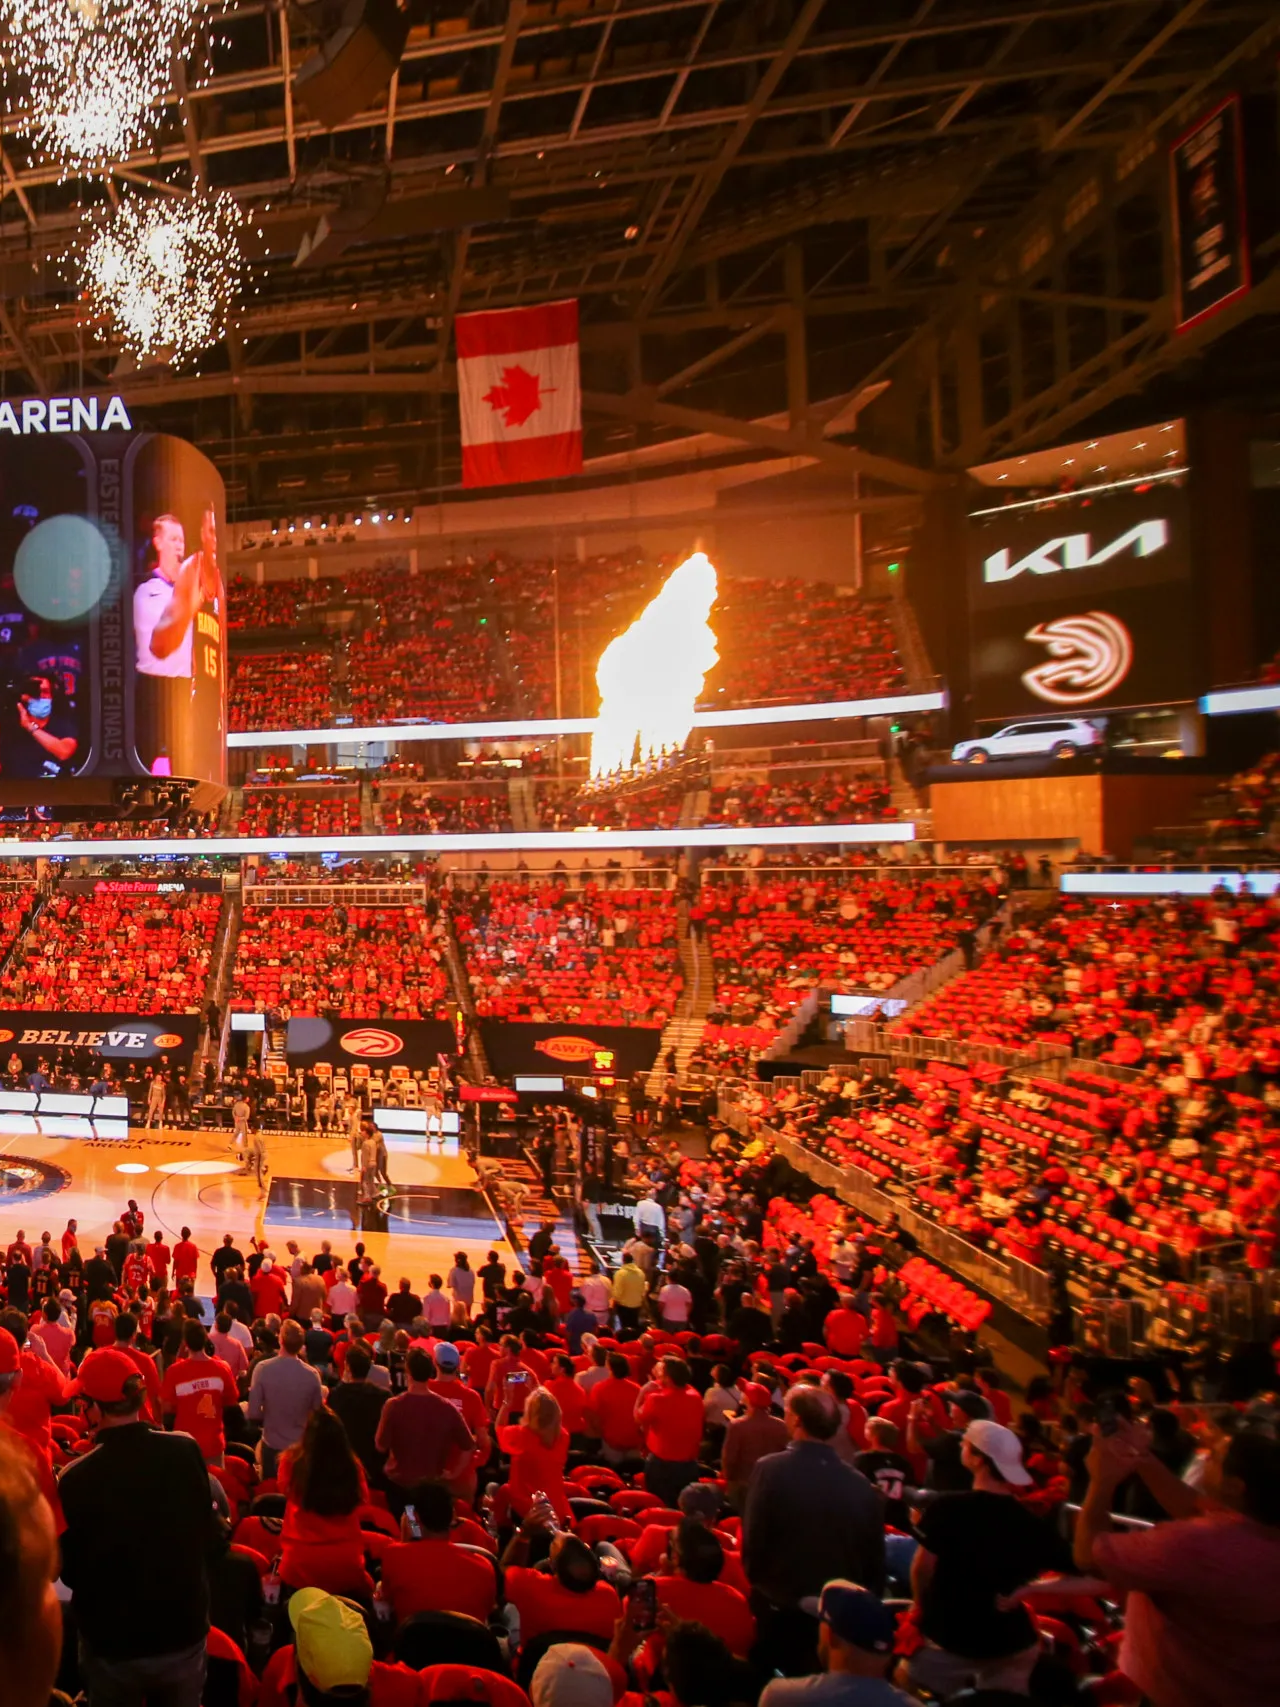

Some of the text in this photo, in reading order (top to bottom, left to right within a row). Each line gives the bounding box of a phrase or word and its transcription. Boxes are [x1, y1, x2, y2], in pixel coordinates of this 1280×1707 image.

[983, 518, 1169, 583] KIA
[203, 644, 218, 678] 15
[103, 693, 123, 760] FINALS
[157, 883, 186, 893] ARENA
[18, 1029, 148, 1049] BELIEVE
[157, 1036, 179, 1045] ATL
[83, 1142, 143, 1150] ARENA
[191, 1379, 210, 1390] WEBB
[196, 1394, 217, 1419] 4
